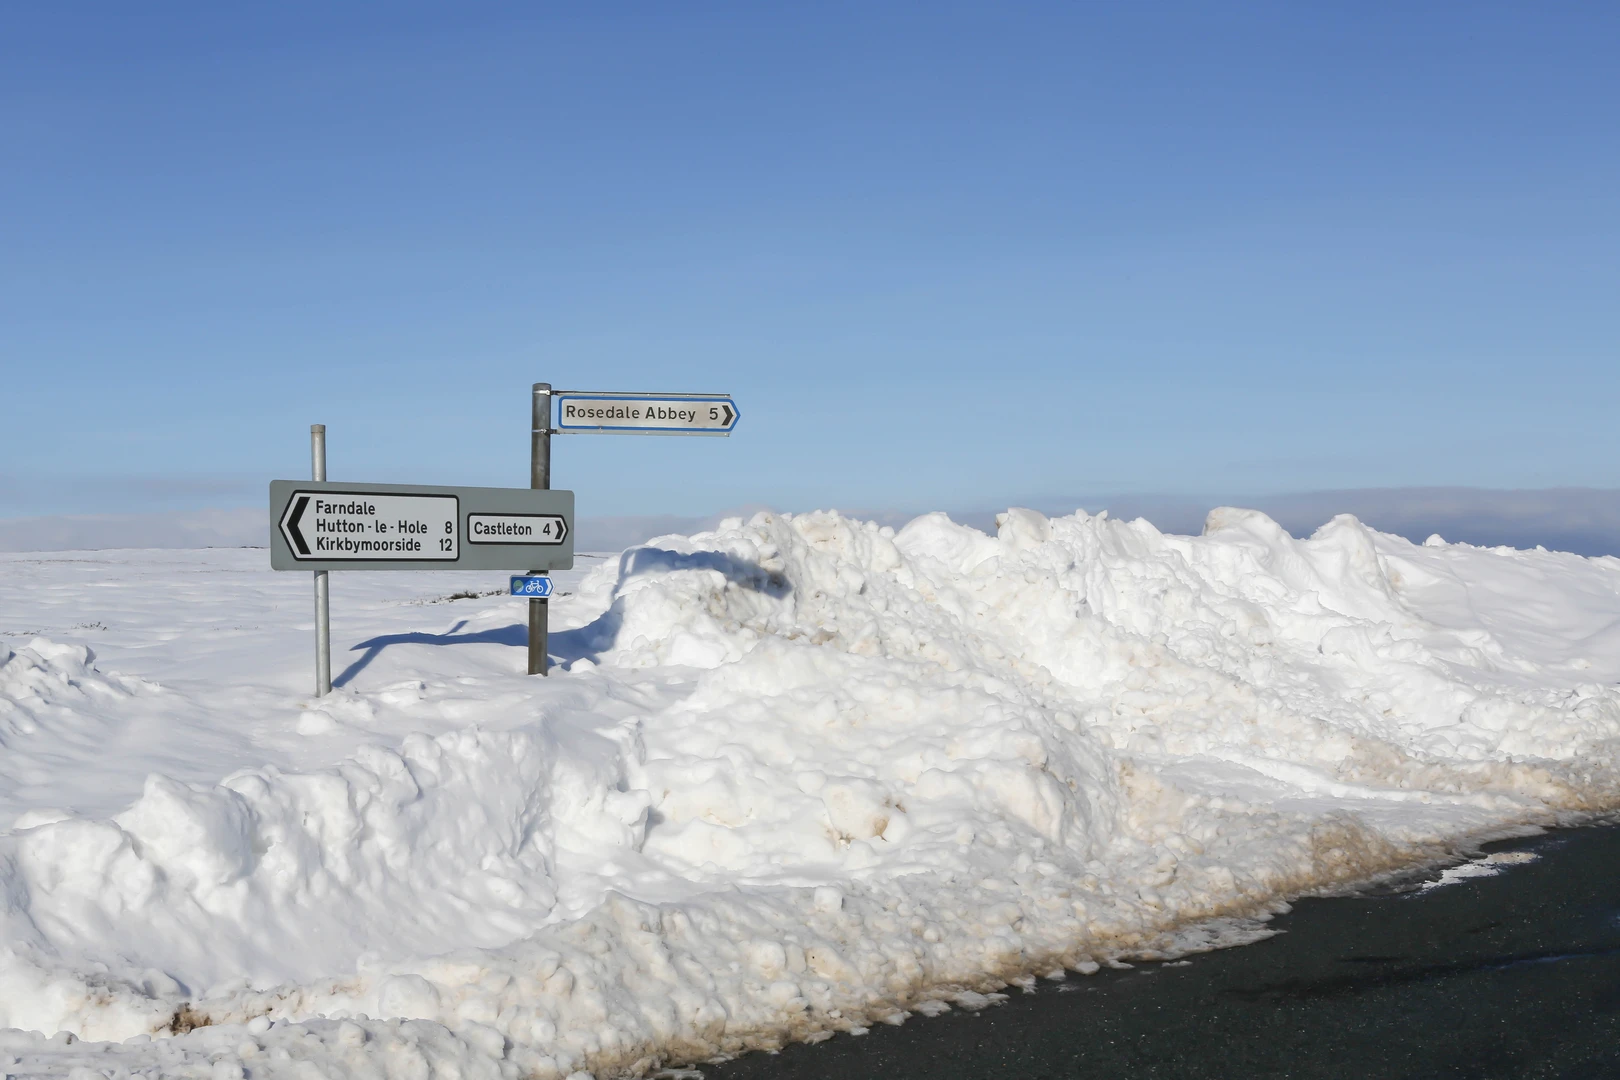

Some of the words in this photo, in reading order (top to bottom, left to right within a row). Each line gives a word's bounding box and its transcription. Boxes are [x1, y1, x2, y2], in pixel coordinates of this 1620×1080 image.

[566, 404, 640, 419] Rosedale
[645, 406, 696, 423] Abbey
[709, 407, 719, 420] 5
[316, 500, 376, 516] Farndale
[444, 521, 453, 534] 8
[474, 521, 532, 536] Castleton
[542, 522, 551, 536] 4
[316, 536, 421, 553] Kirkbymoorside
[439, 538, 453, 551] 12
